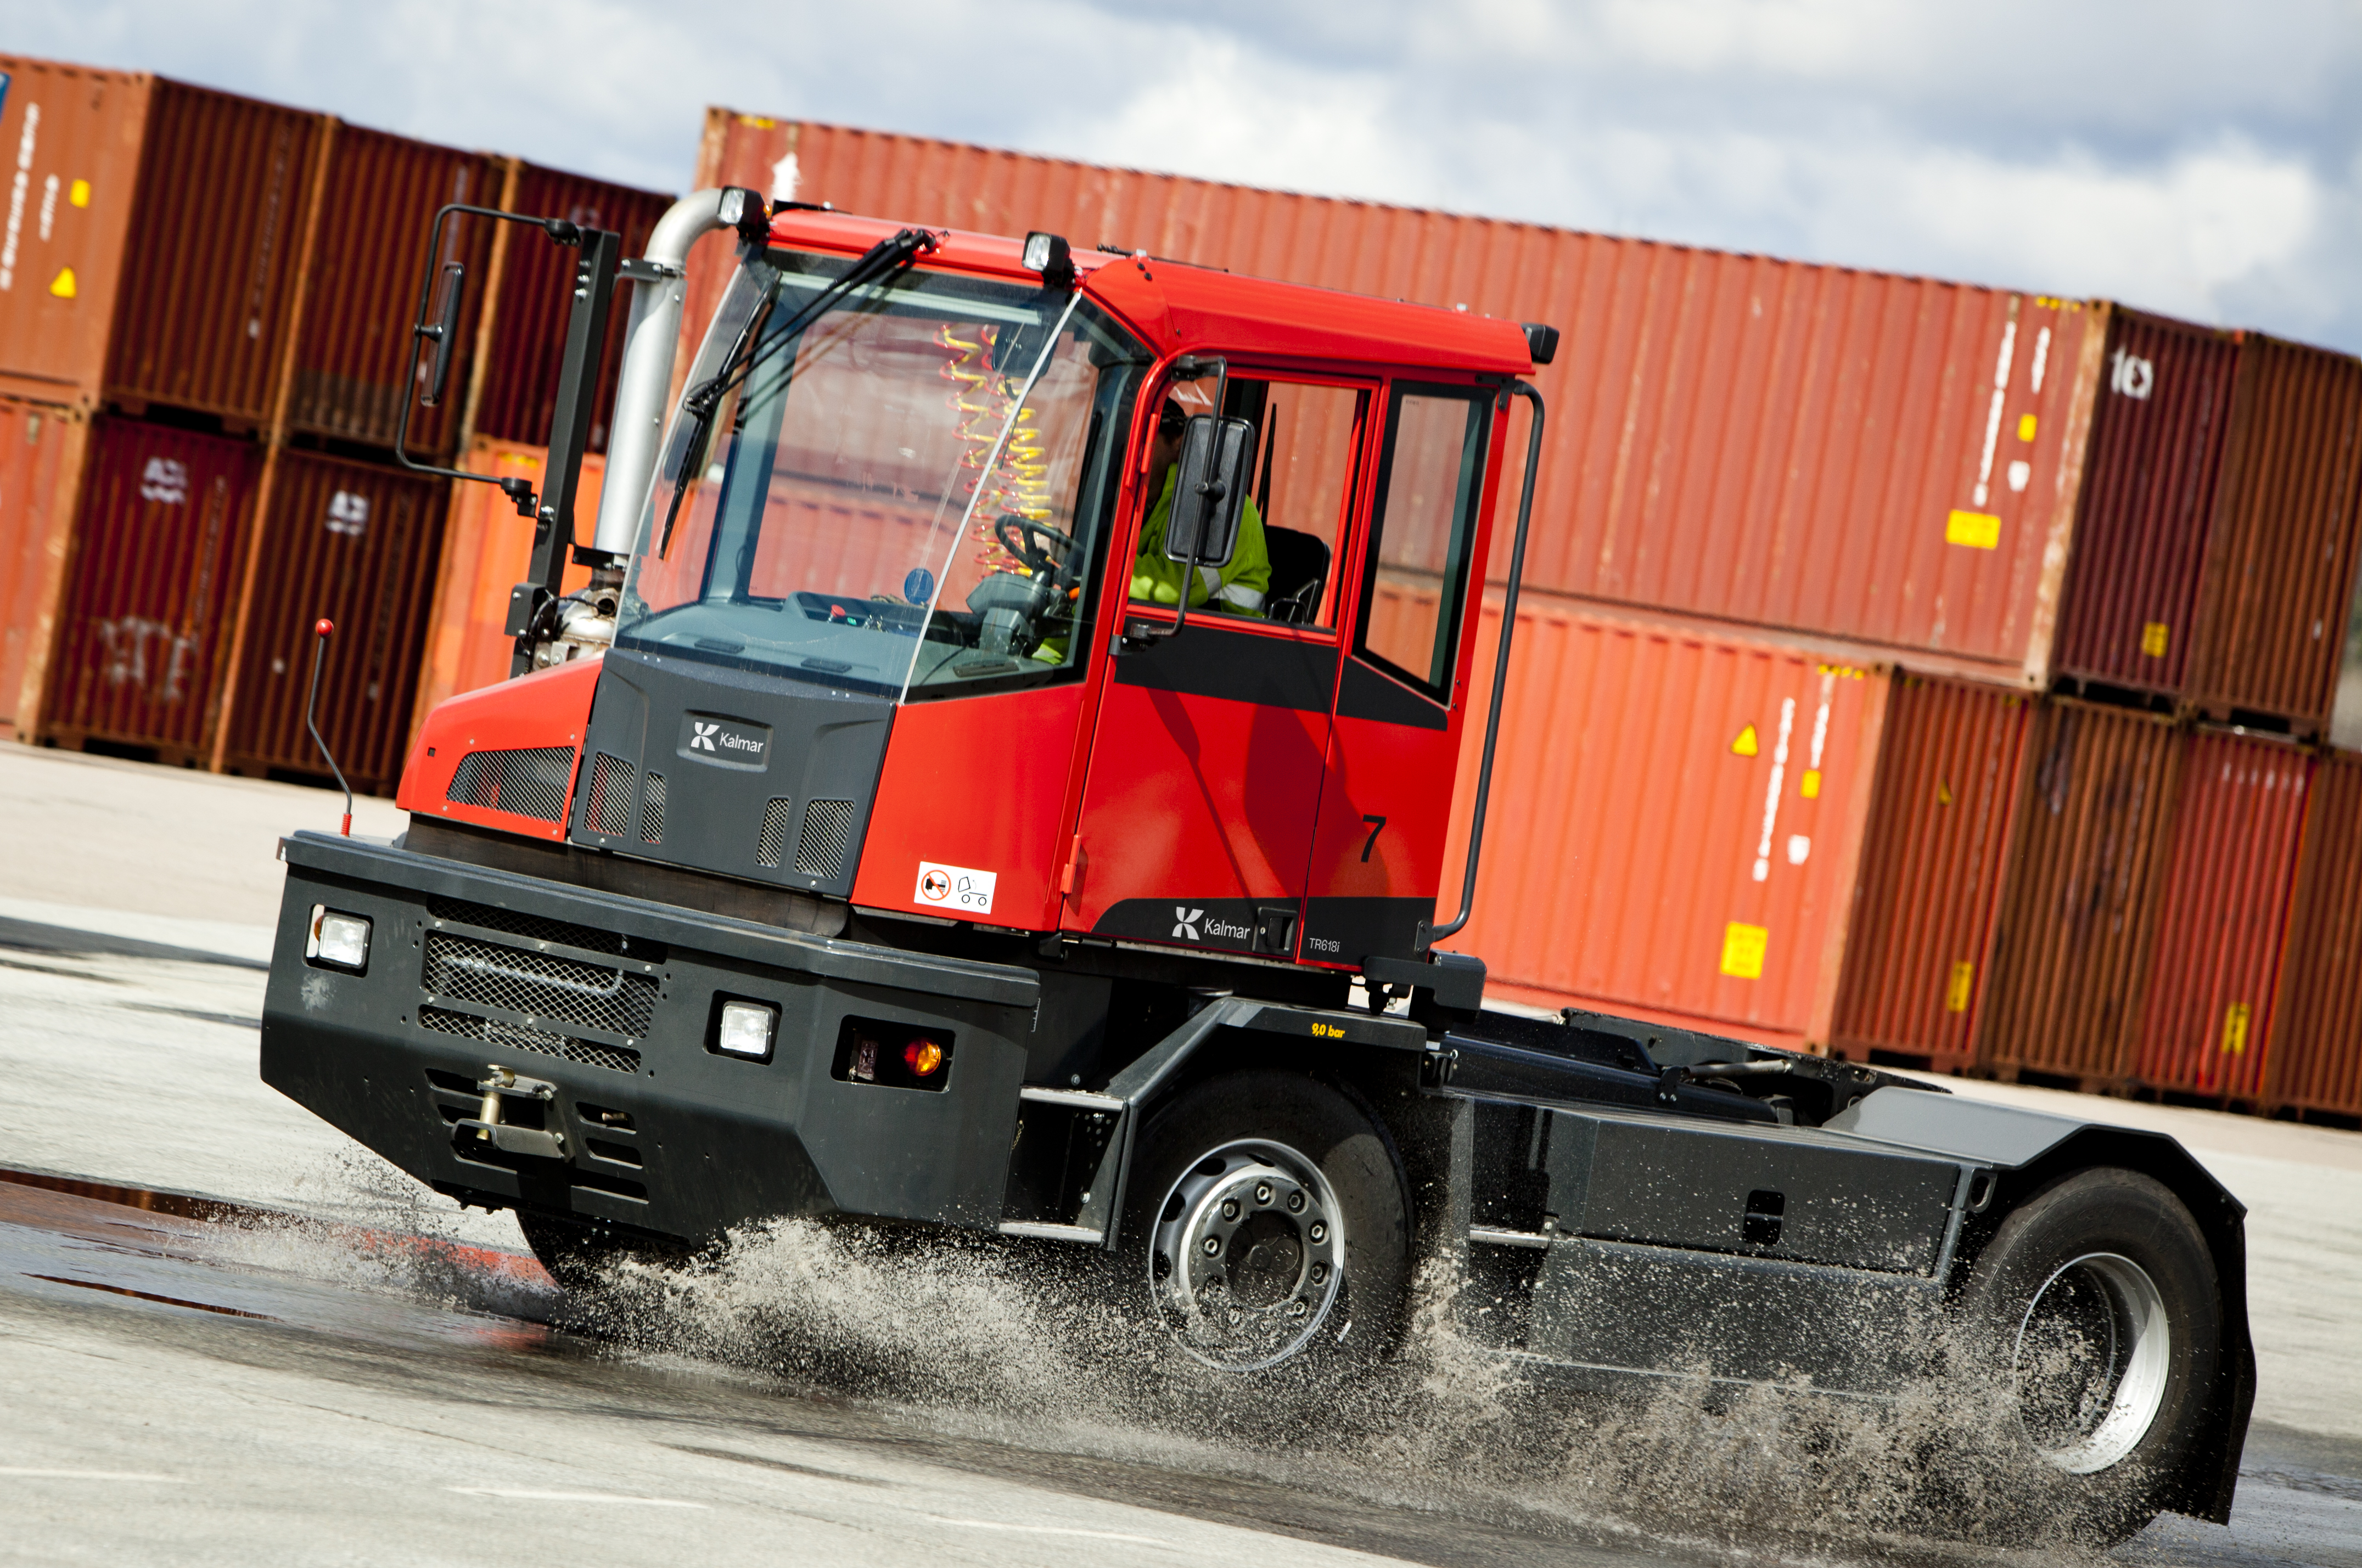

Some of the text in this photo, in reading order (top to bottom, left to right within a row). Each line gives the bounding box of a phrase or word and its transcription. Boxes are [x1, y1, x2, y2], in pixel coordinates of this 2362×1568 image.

[720, 733, 764, 752] Kalmar
[1361, 814, 1387, 862] 7
[1204, 918, 1250, 939] Kalmar
[1309, 937, 1340, 952] TR618i
[1312, 1022, 1345, 1038] 9,0 bar
